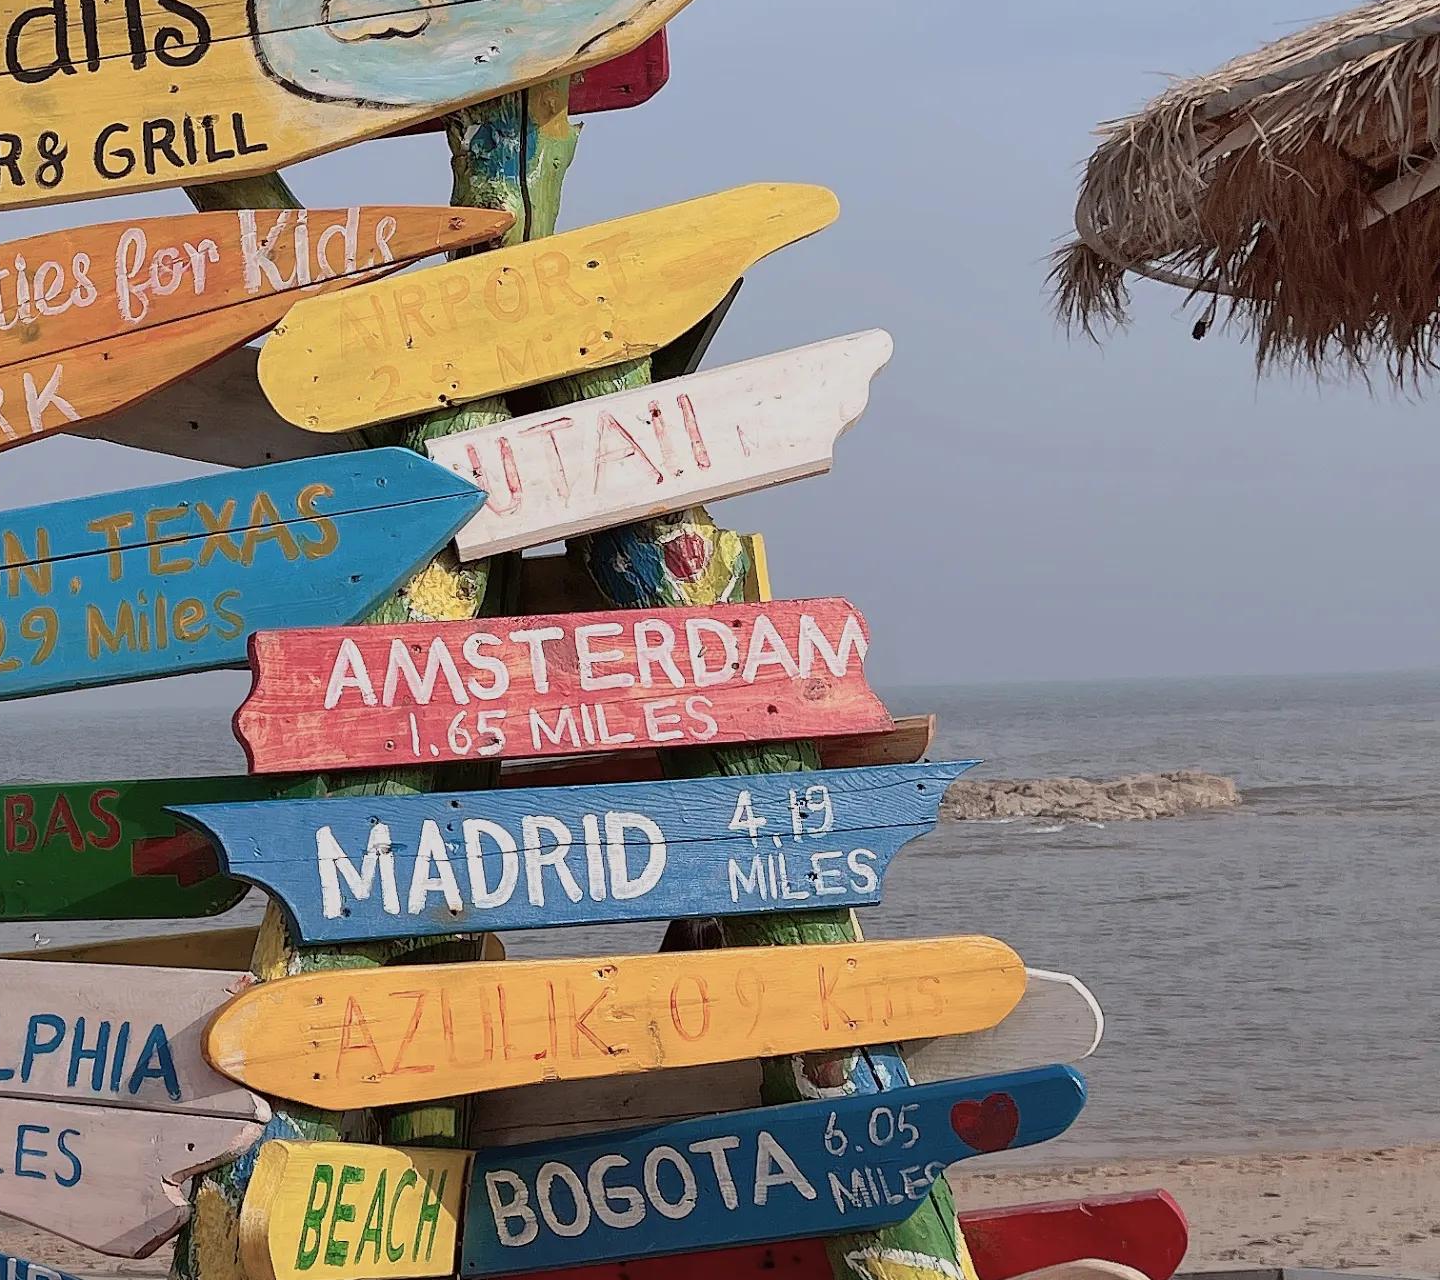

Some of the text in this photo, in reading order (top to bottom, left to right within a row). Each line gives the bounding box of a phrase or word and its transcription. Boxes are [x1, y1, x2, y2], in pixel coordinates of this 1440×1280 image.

[93, 112, 267, 180] GRILL
[115, 227, 219, 322] for
[237, 208, 398, 294] Kids
[340, 232, 630, 359] AIRPORT
[89, 484, 341, 583] TEXAS
[87, 588, 245, 660] Miles
[324, 615, 868, 710] AMSTERDAM
[409, 695, 720, 757] 1.65 MILES
[315, 811, 668, 919] MADRID
[729, 849, 879, 904] MILES
[823, 1104, 923, 1157] 6.05
[294, 1164, 447, 1271] BEACH
[485, 1131, 817, 1248] BOGOTA
